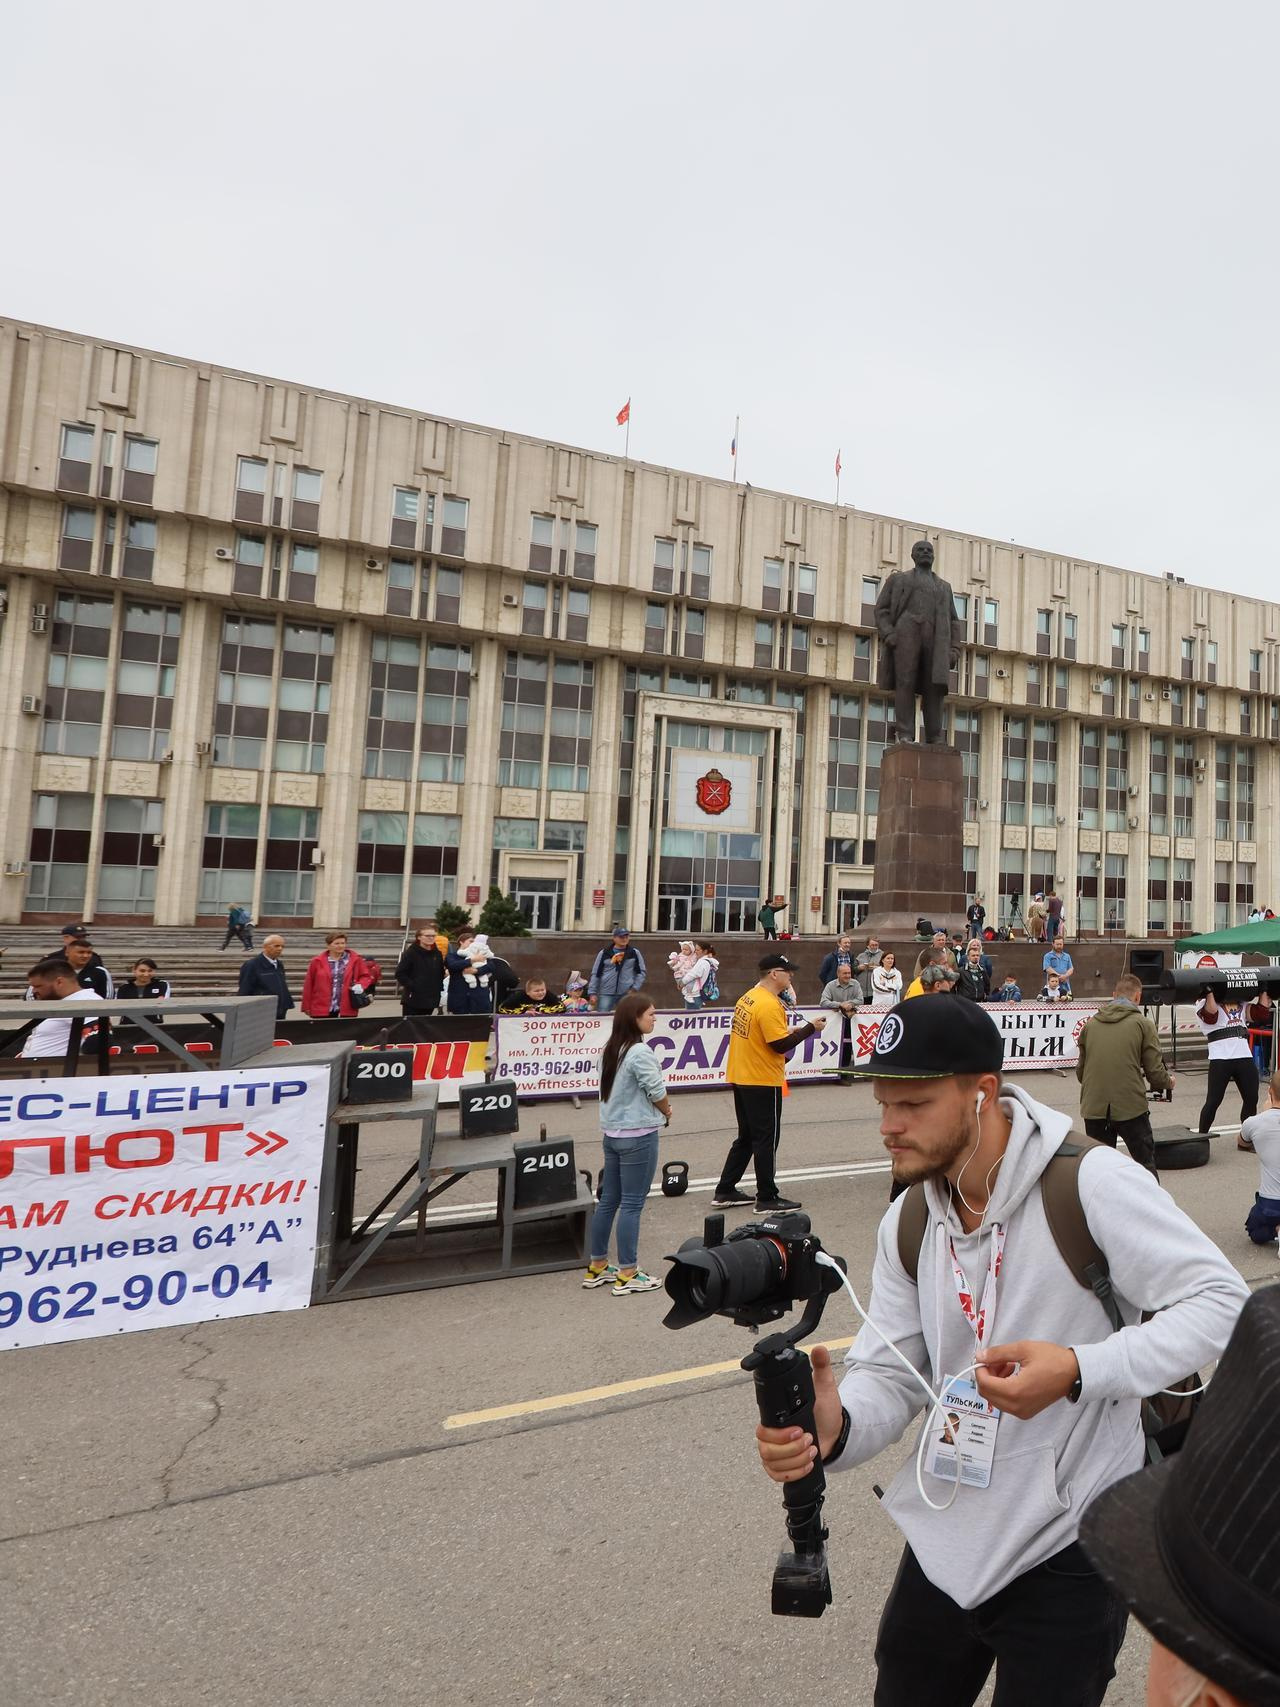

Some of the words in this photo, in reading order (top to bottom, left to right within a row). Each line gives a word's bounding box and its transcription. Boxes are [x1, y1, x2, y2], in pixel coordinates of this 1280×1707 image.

[523, 1021, 547, 1032] 300
[551, 1021, 600, 1031] метров
[668, 1015, 735, 1030] ФИТНЕ
[1001, 1014, 1065, 1029] БЫТЬ
[531, 1036, 547, 1044] от
[551, 1032, 585, 1043] ТГПУ
[531, 1047, 555, 1056] Л.Н.
[1001, 1036, 1064, 1057] ЫМ
[356, 1062, 406, 1079] 200
[500, 1059, 599, 1077] 8-953-962-90-
[669, 1073, 714, 1082] Николая
[469, 1094, 512, 1113] 220
[522, 1152, 569, 1174] 240
[668, 1176, 679, 1184] 24
[94, 1179, 307, 1220] СКИДКИ!
